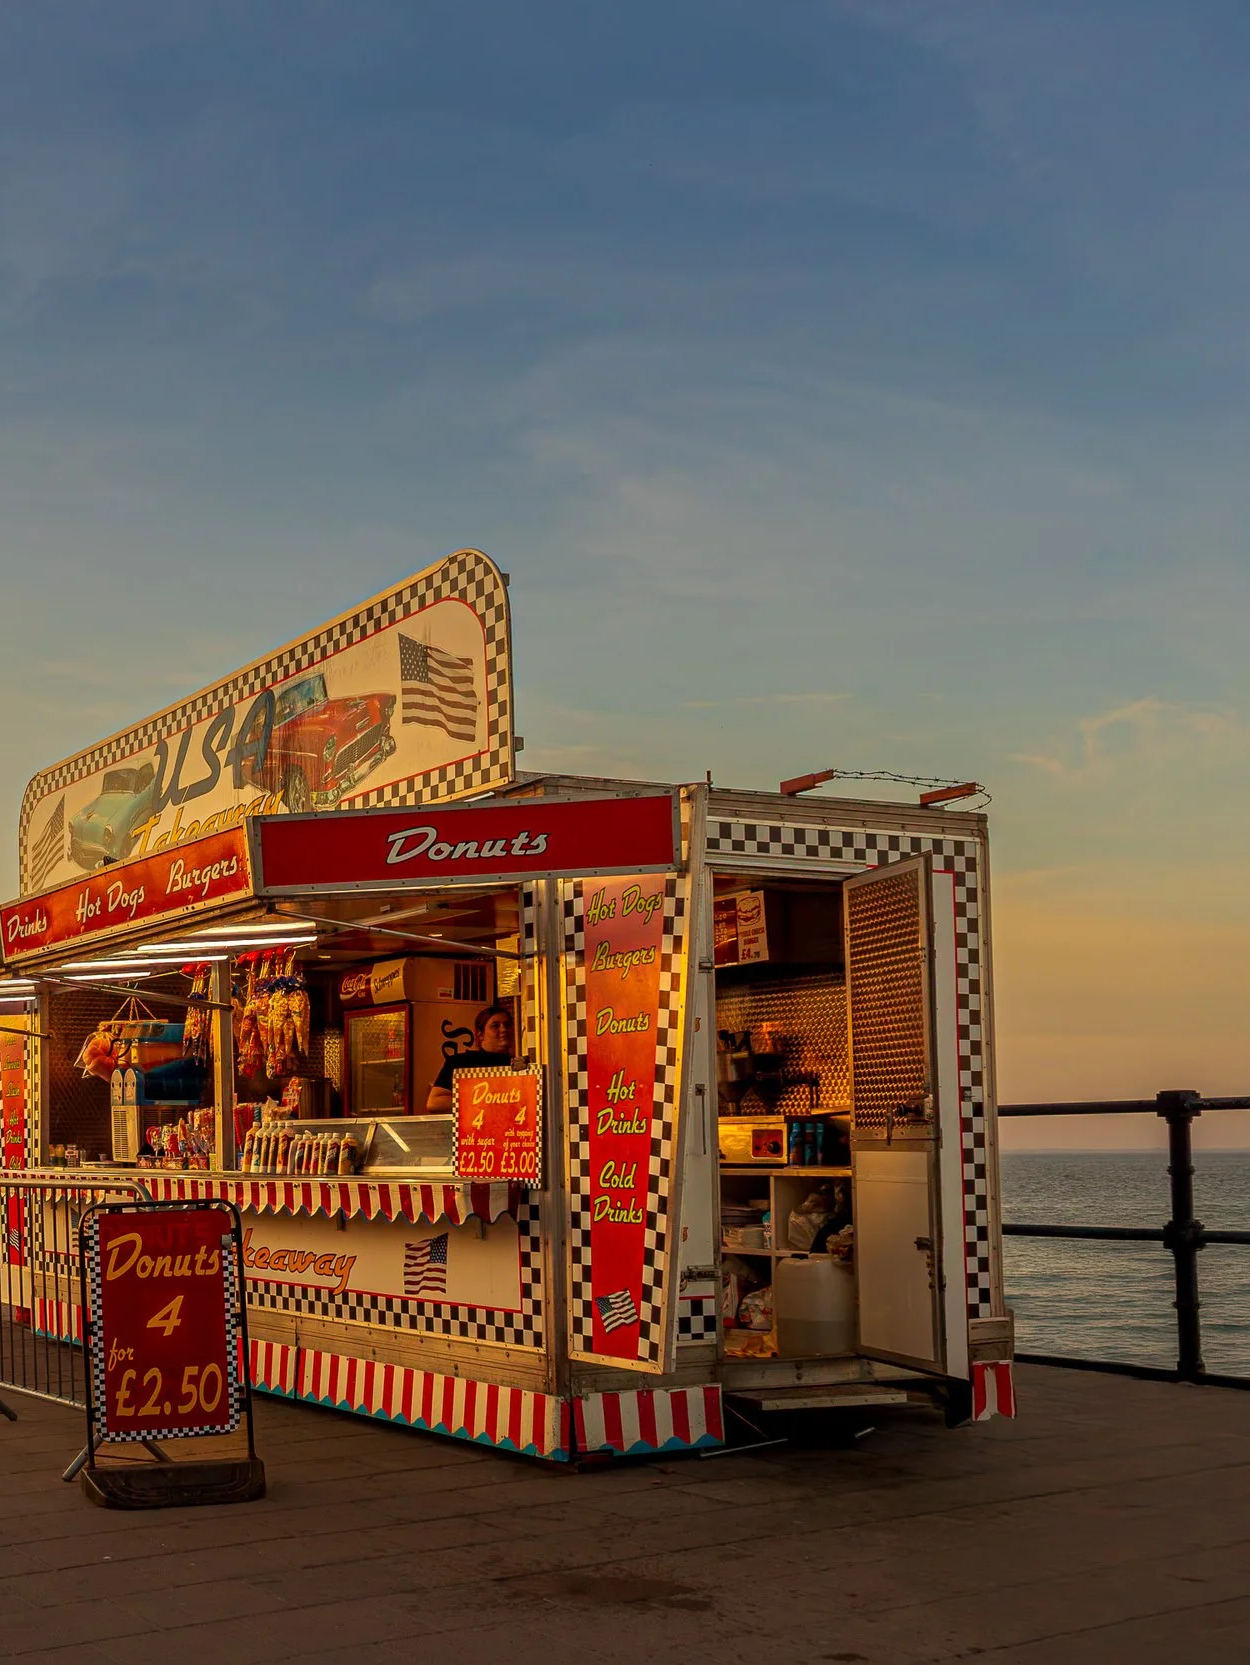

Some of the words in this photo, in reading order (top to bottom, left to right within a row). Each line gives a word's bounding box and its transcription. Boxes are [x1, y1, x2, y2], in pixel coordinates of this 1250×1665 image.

[153, 689, 276, 813] USA
[385, 825, 550, 865] Donuts
[6, 908, 47, 943] Drinks
[75, 887, 102, 925] Hot
[106, 880, 146, 918] Dogs
[165, 854, 239, 897] Burgers
[586, 886, 617, 926] Hot
[621, 883, 664, 926] Dogs
[590, 940, 657, 980] Burgers
[596, 1006, 650, 1037] Donuts
[472, 1081, 521, 1106] Donuts
[607, 1067, 637, 1105] Hot
[471, 1109, 485, 1130] 4
[515, 1106, 527, 1126] 4
[596, 1106, 649, 1136] Drinks
[461, 1132, 475, 1146] with
[476, 1137, 495, 1151] sugar
[459, 1151, 495, 1173] £2.50
[500, 1151, 535, 1174] £3.00
[598, 1159, 638, 1190] Cold
[593, 1193, 644, 1223] Drinks
[105, 1232, 220, 1281] Donuts
[234, 1227, 357, 1296] keaway
[146, 1294, 184, 1337] 4
[107, 1337, 135, 1372] for
[115, 1363, 223, 1417] £2.50
